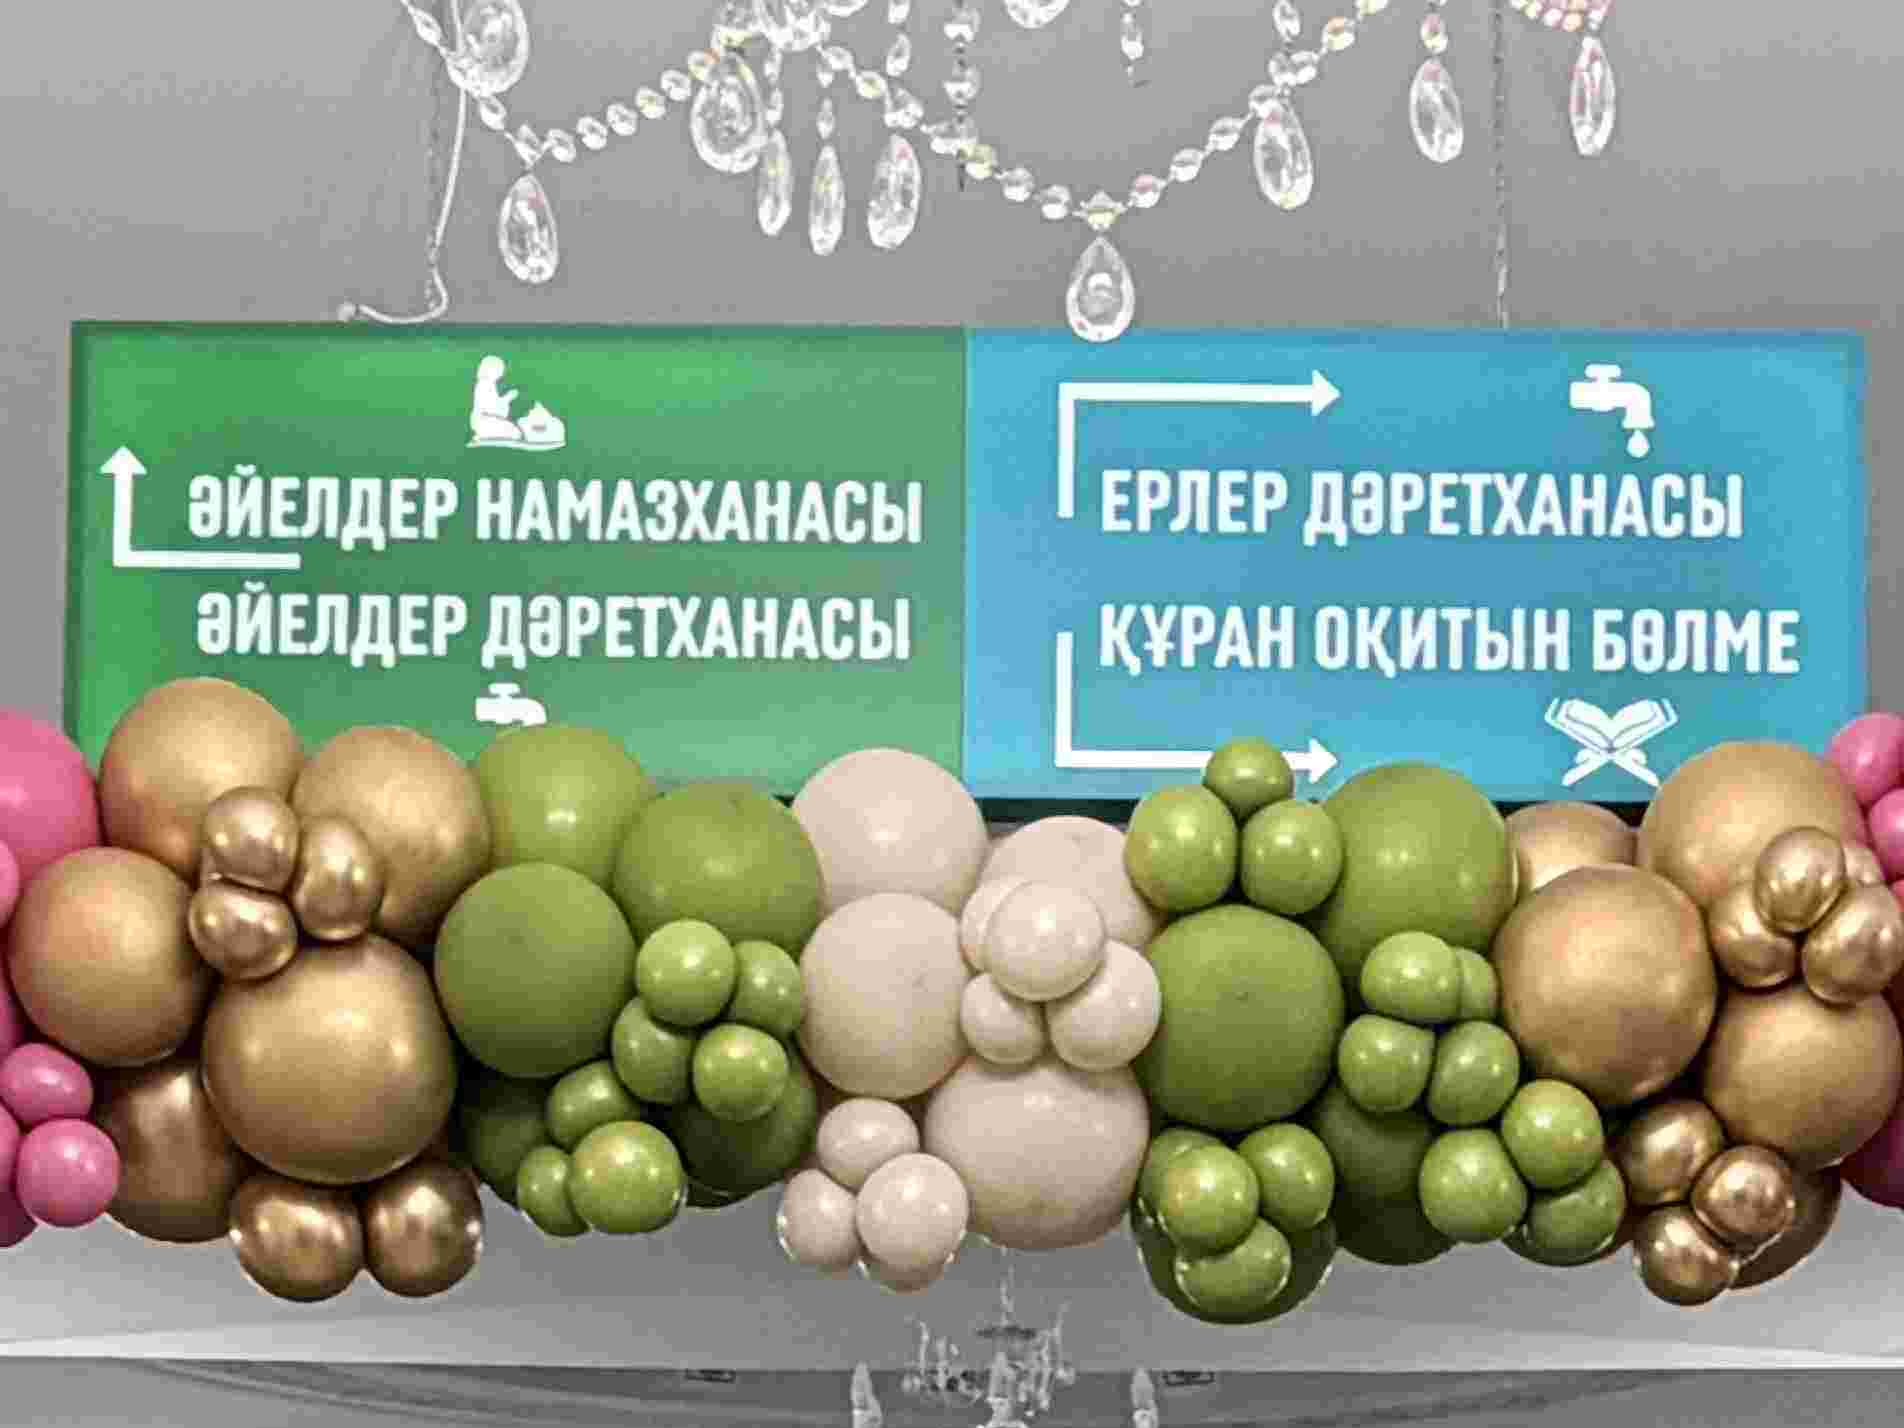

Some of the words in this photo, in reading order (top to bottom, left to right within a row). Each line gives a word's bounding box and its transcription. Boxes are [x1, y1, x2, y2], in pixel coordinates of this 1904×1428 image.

[187, 463, 459, 552] ӘЙЕЛДЕР
[475, 477, 923, 544] НАМАЗХАНАСЫ
[1101, 468, 1289, 534] ЕРЛЕР
[1303, 470, 1744, 547] ДӘРЕТХАНАСЫ
[195, 579, 469, 669] ӘЙЕЛДЕР
[480, 593, 912, 670] ДӘРЕТХАНАСЫ
[1099, 603, 1296, 676] ҚҰРАН
[1314, 605, 1571, 679] ОҚИТЫН
[1592, 608, 1801, 674] БӨЛМЕ
